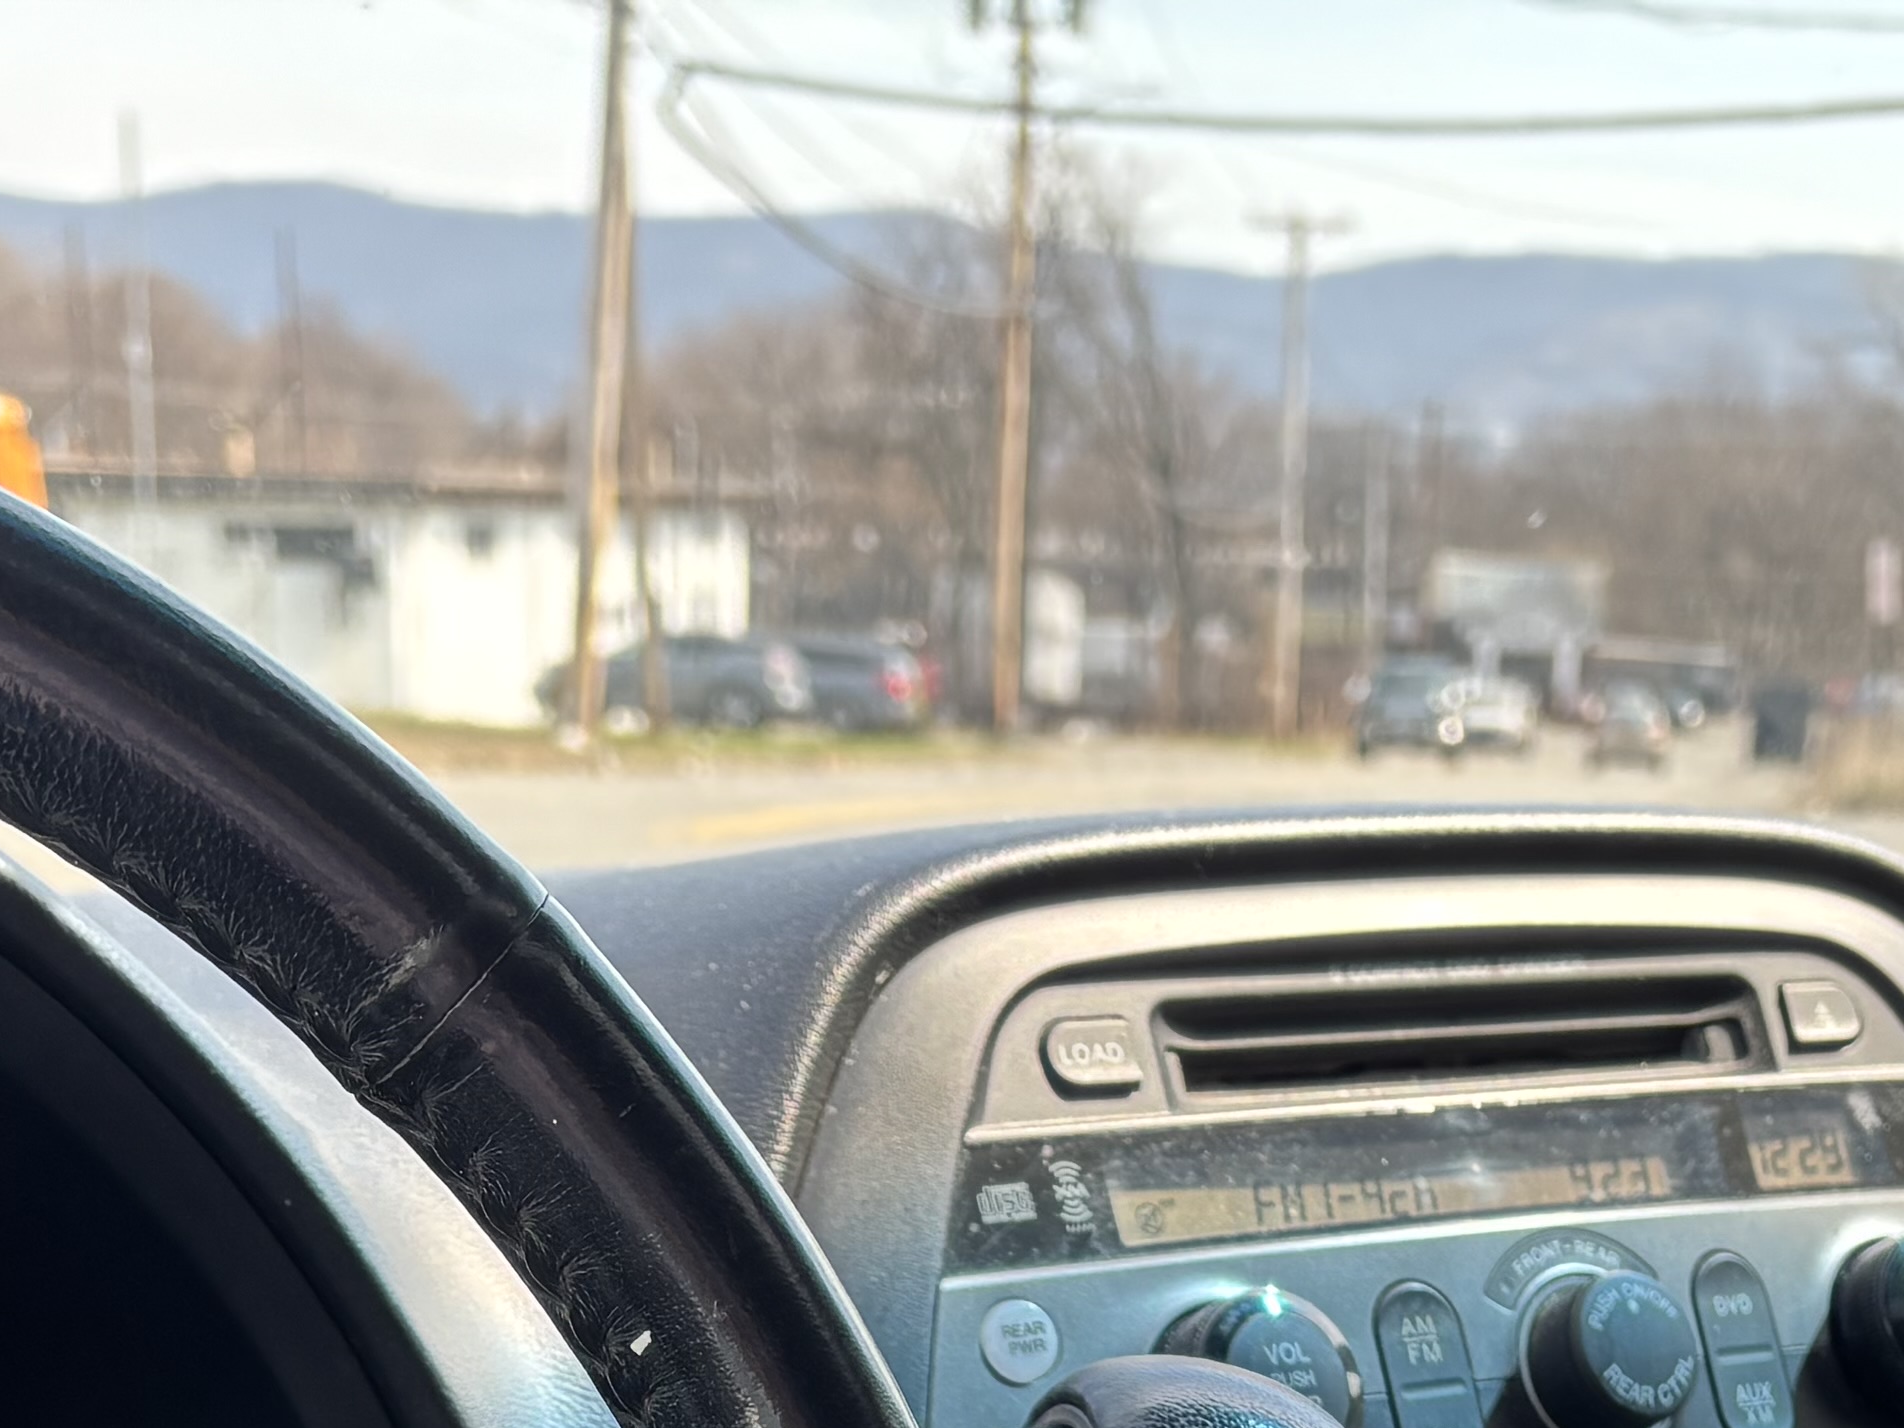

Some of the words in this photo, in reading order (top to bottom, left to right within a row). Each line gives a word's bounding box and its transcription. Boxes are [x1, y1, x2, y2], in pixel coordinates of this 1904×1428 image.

[1057, 1041, 1124, 1067] LOAD
[1711, 1292, 1754, 1318] DVD
[1001, 1320, 1047, 1340] REAR
[1400, 1314, 1439, 1337] AM
[1007, 1337, 1049, 1358] PWR
[1262, 1341, 1312, 1367] VOL
[1407, 1340, 1444, 1365] FM
[1602, 1361, 1655, 1407] REAR
[1735, 1380, 1774, 1403] AUX
